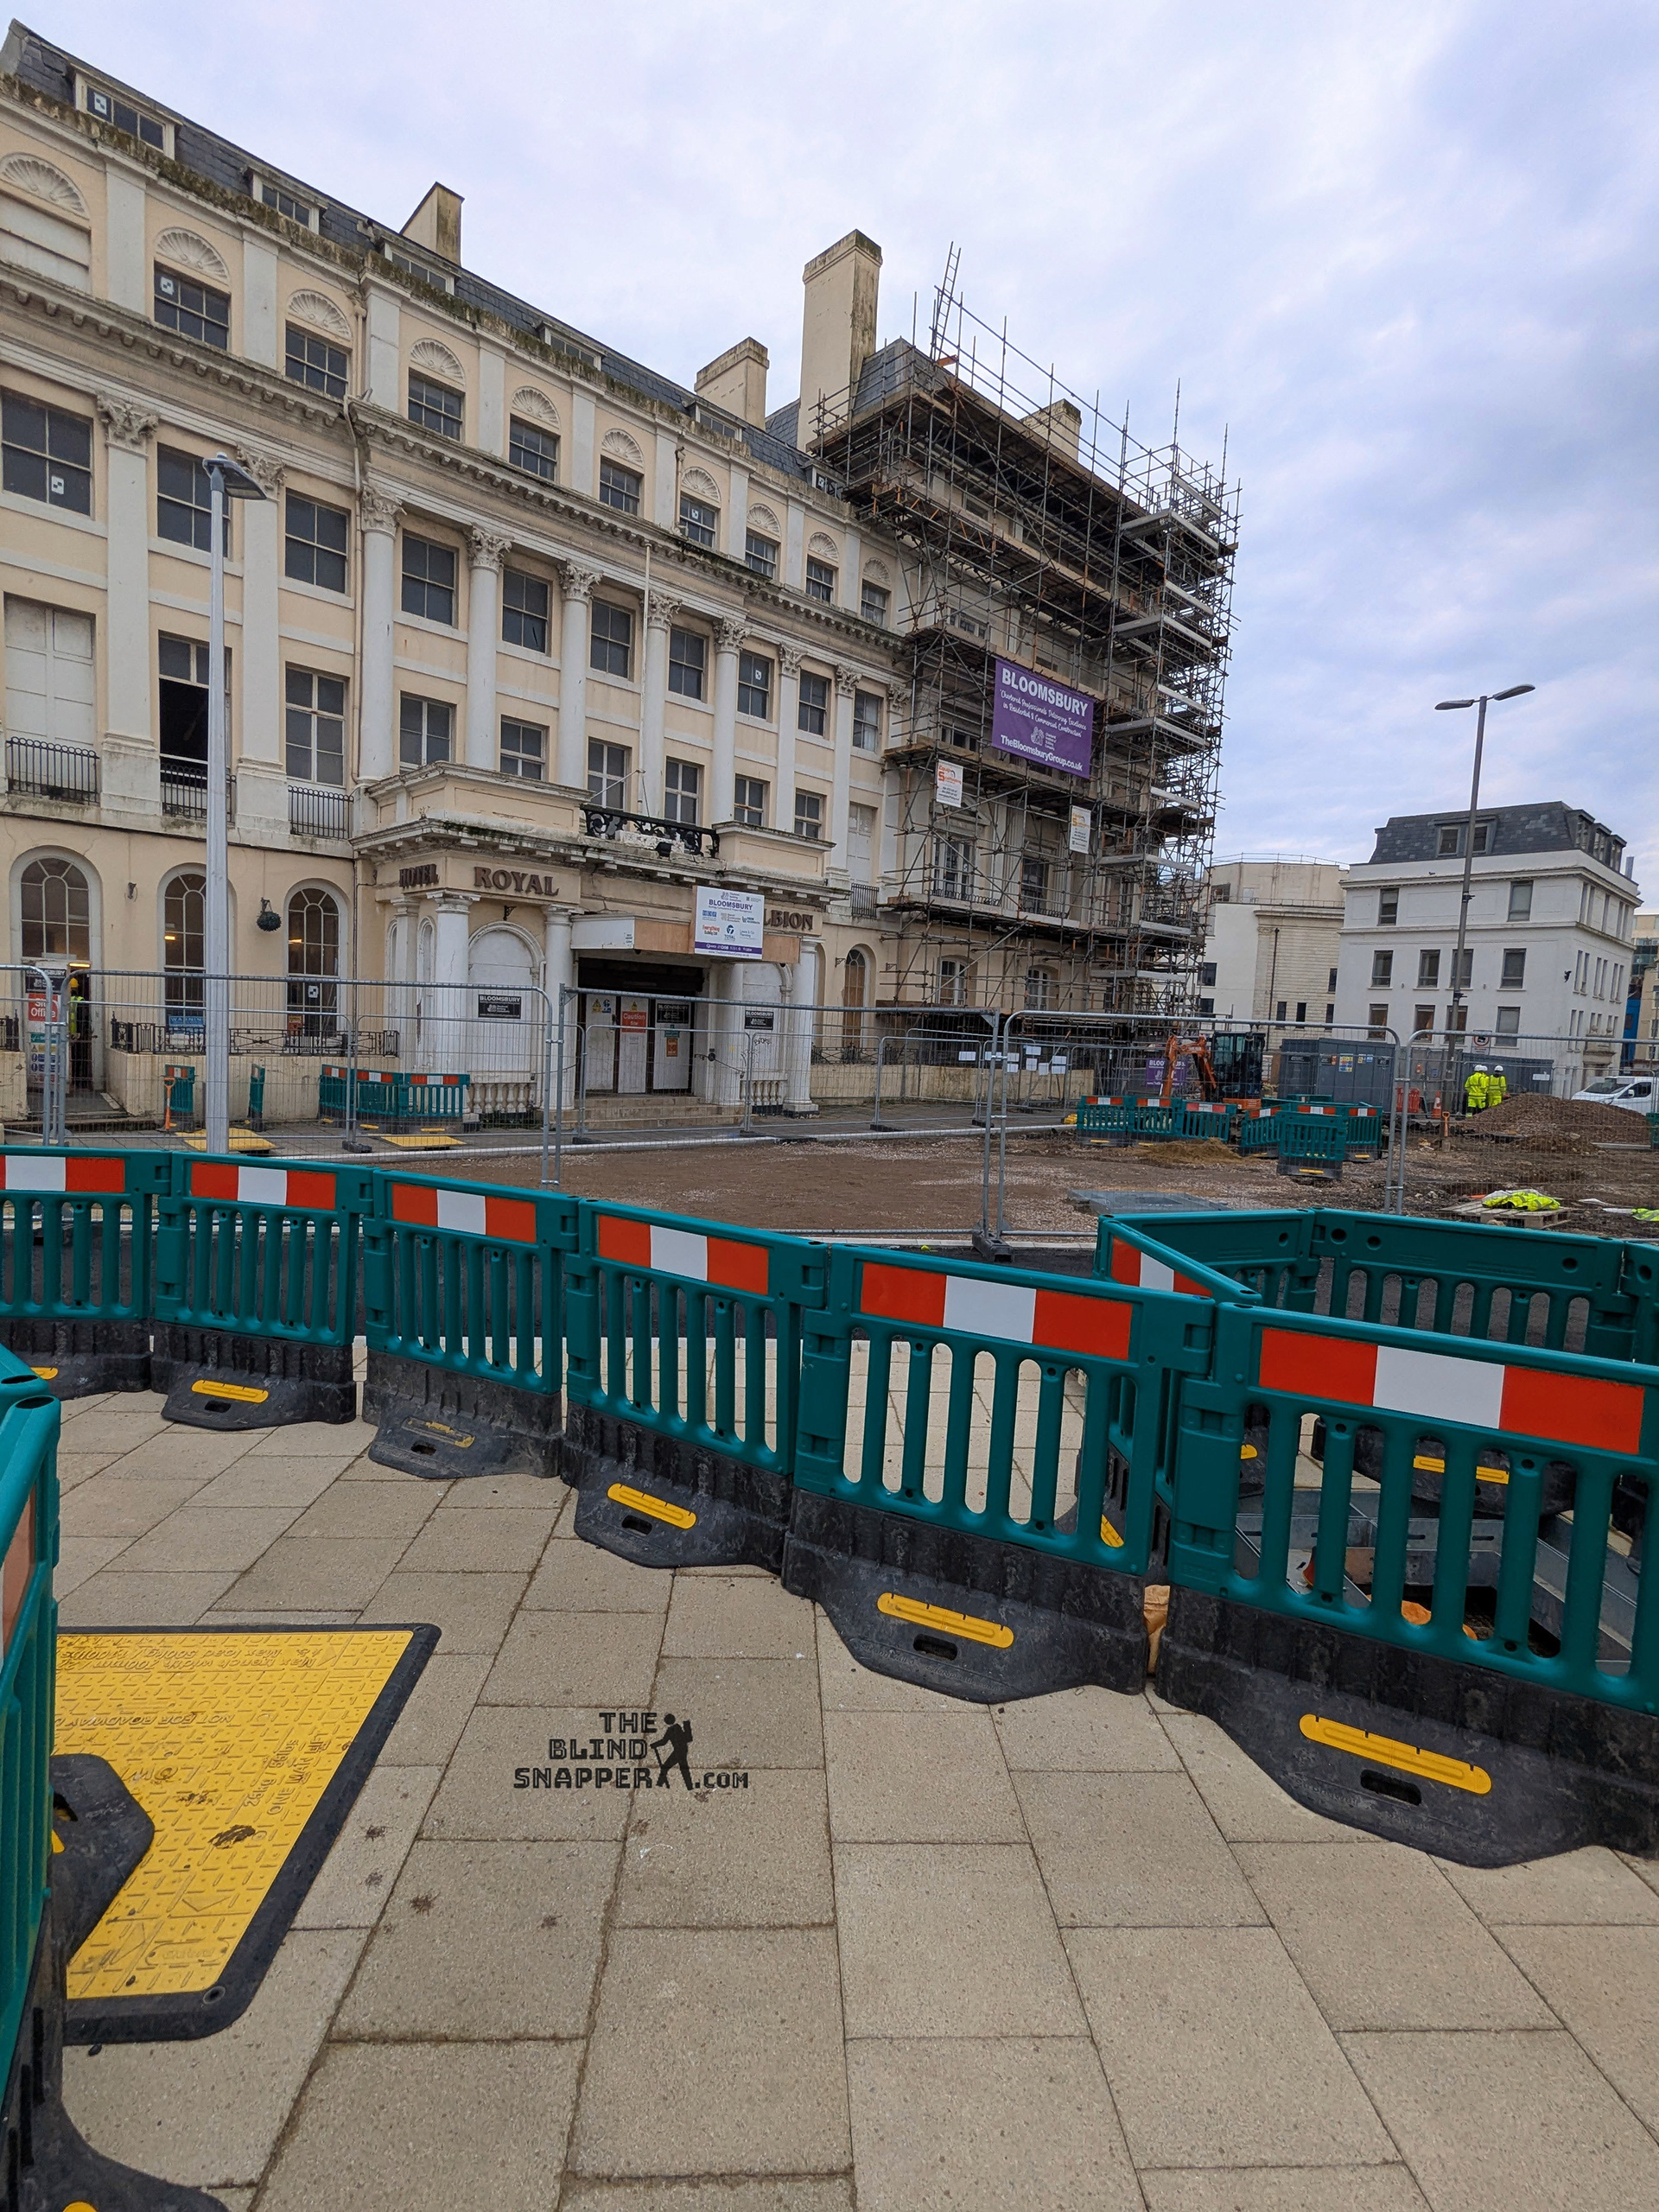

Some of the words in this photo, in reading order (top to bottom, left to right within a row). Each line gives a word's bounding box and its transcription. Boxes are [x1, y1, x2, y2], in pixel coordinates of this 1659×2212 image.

[1002, 667, 1089, 716] BLOOMSBURY
[1001, 734, 1084, 772] TheBloomsburyGroup.co.uk
[399, 864, 440, 888] HOTEL
[474, 867, 560, 897] ROYAL
[709, 899, 753, 911] BLOOMSBURY
[764, 908, 813, 931] LBION
[30, 1007, 55, 1017] Offie
[65, 1715, 158, 1727] ROADWAY
[161, 1713, 197, 1725] FOR
[195, 1713, 235, 1725] NOT
[267, 1788, 296, 1815] ONE
